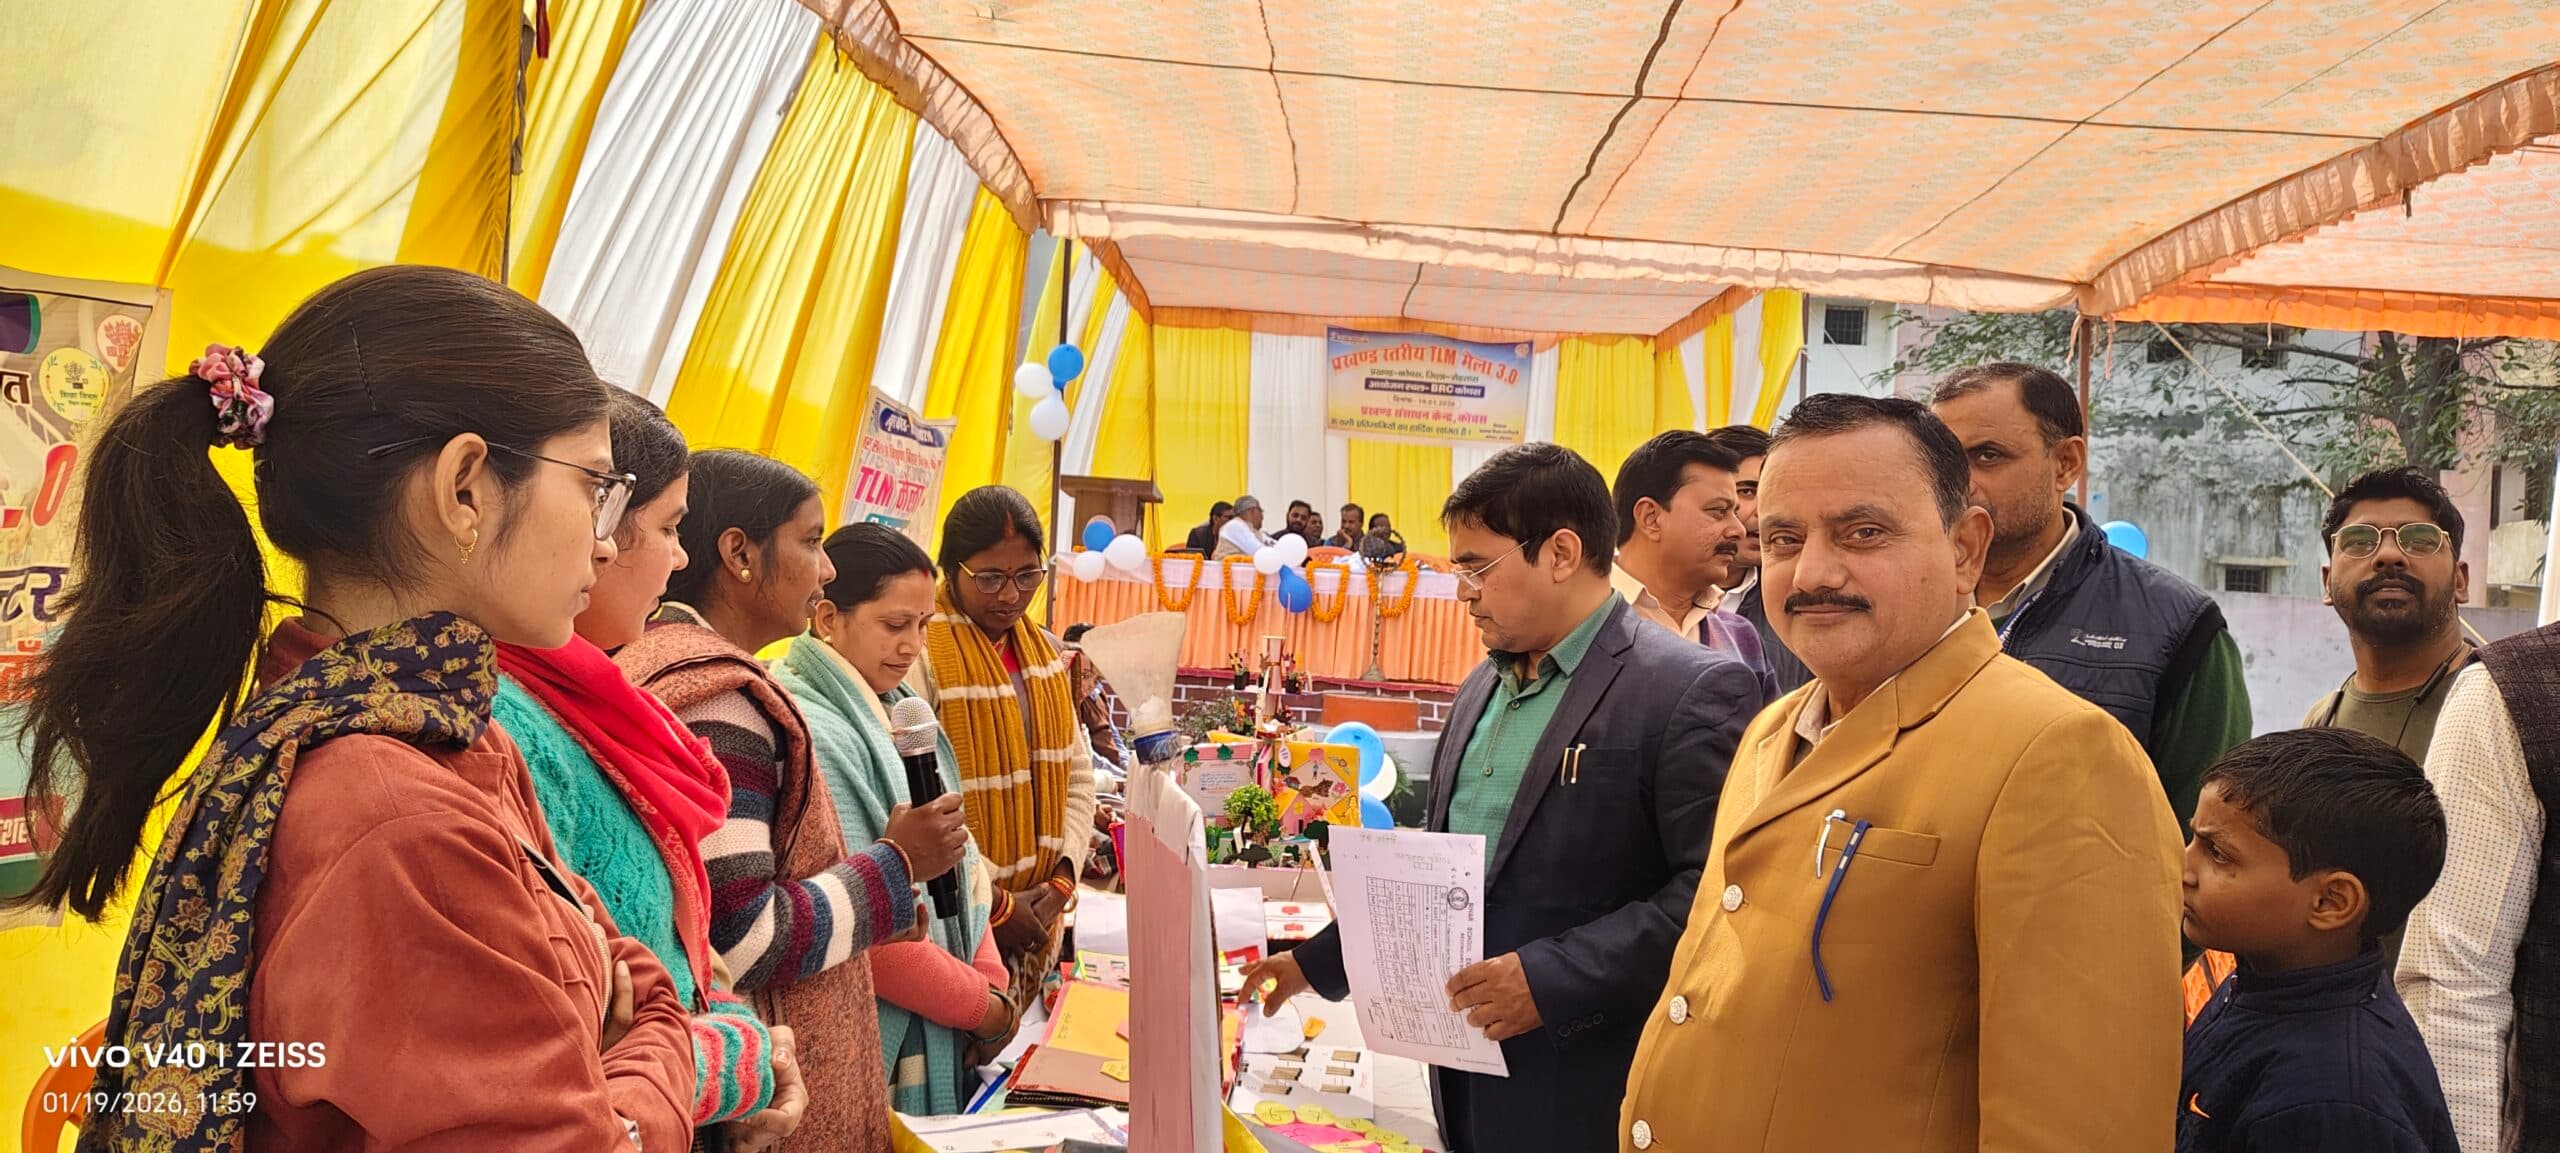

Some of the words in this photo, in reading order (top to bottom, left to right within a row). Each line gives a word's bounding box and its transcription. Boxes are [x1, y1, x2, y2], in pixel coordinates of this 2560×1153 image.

[1430, 345, 1457, 366] TLM
[1462, 350, 1493, 375] मेला
[1496, 362, 1520, 385] 3.0
[1430, 383, 1454, 394] BRC
[855, 465, 893, 508] TLM
